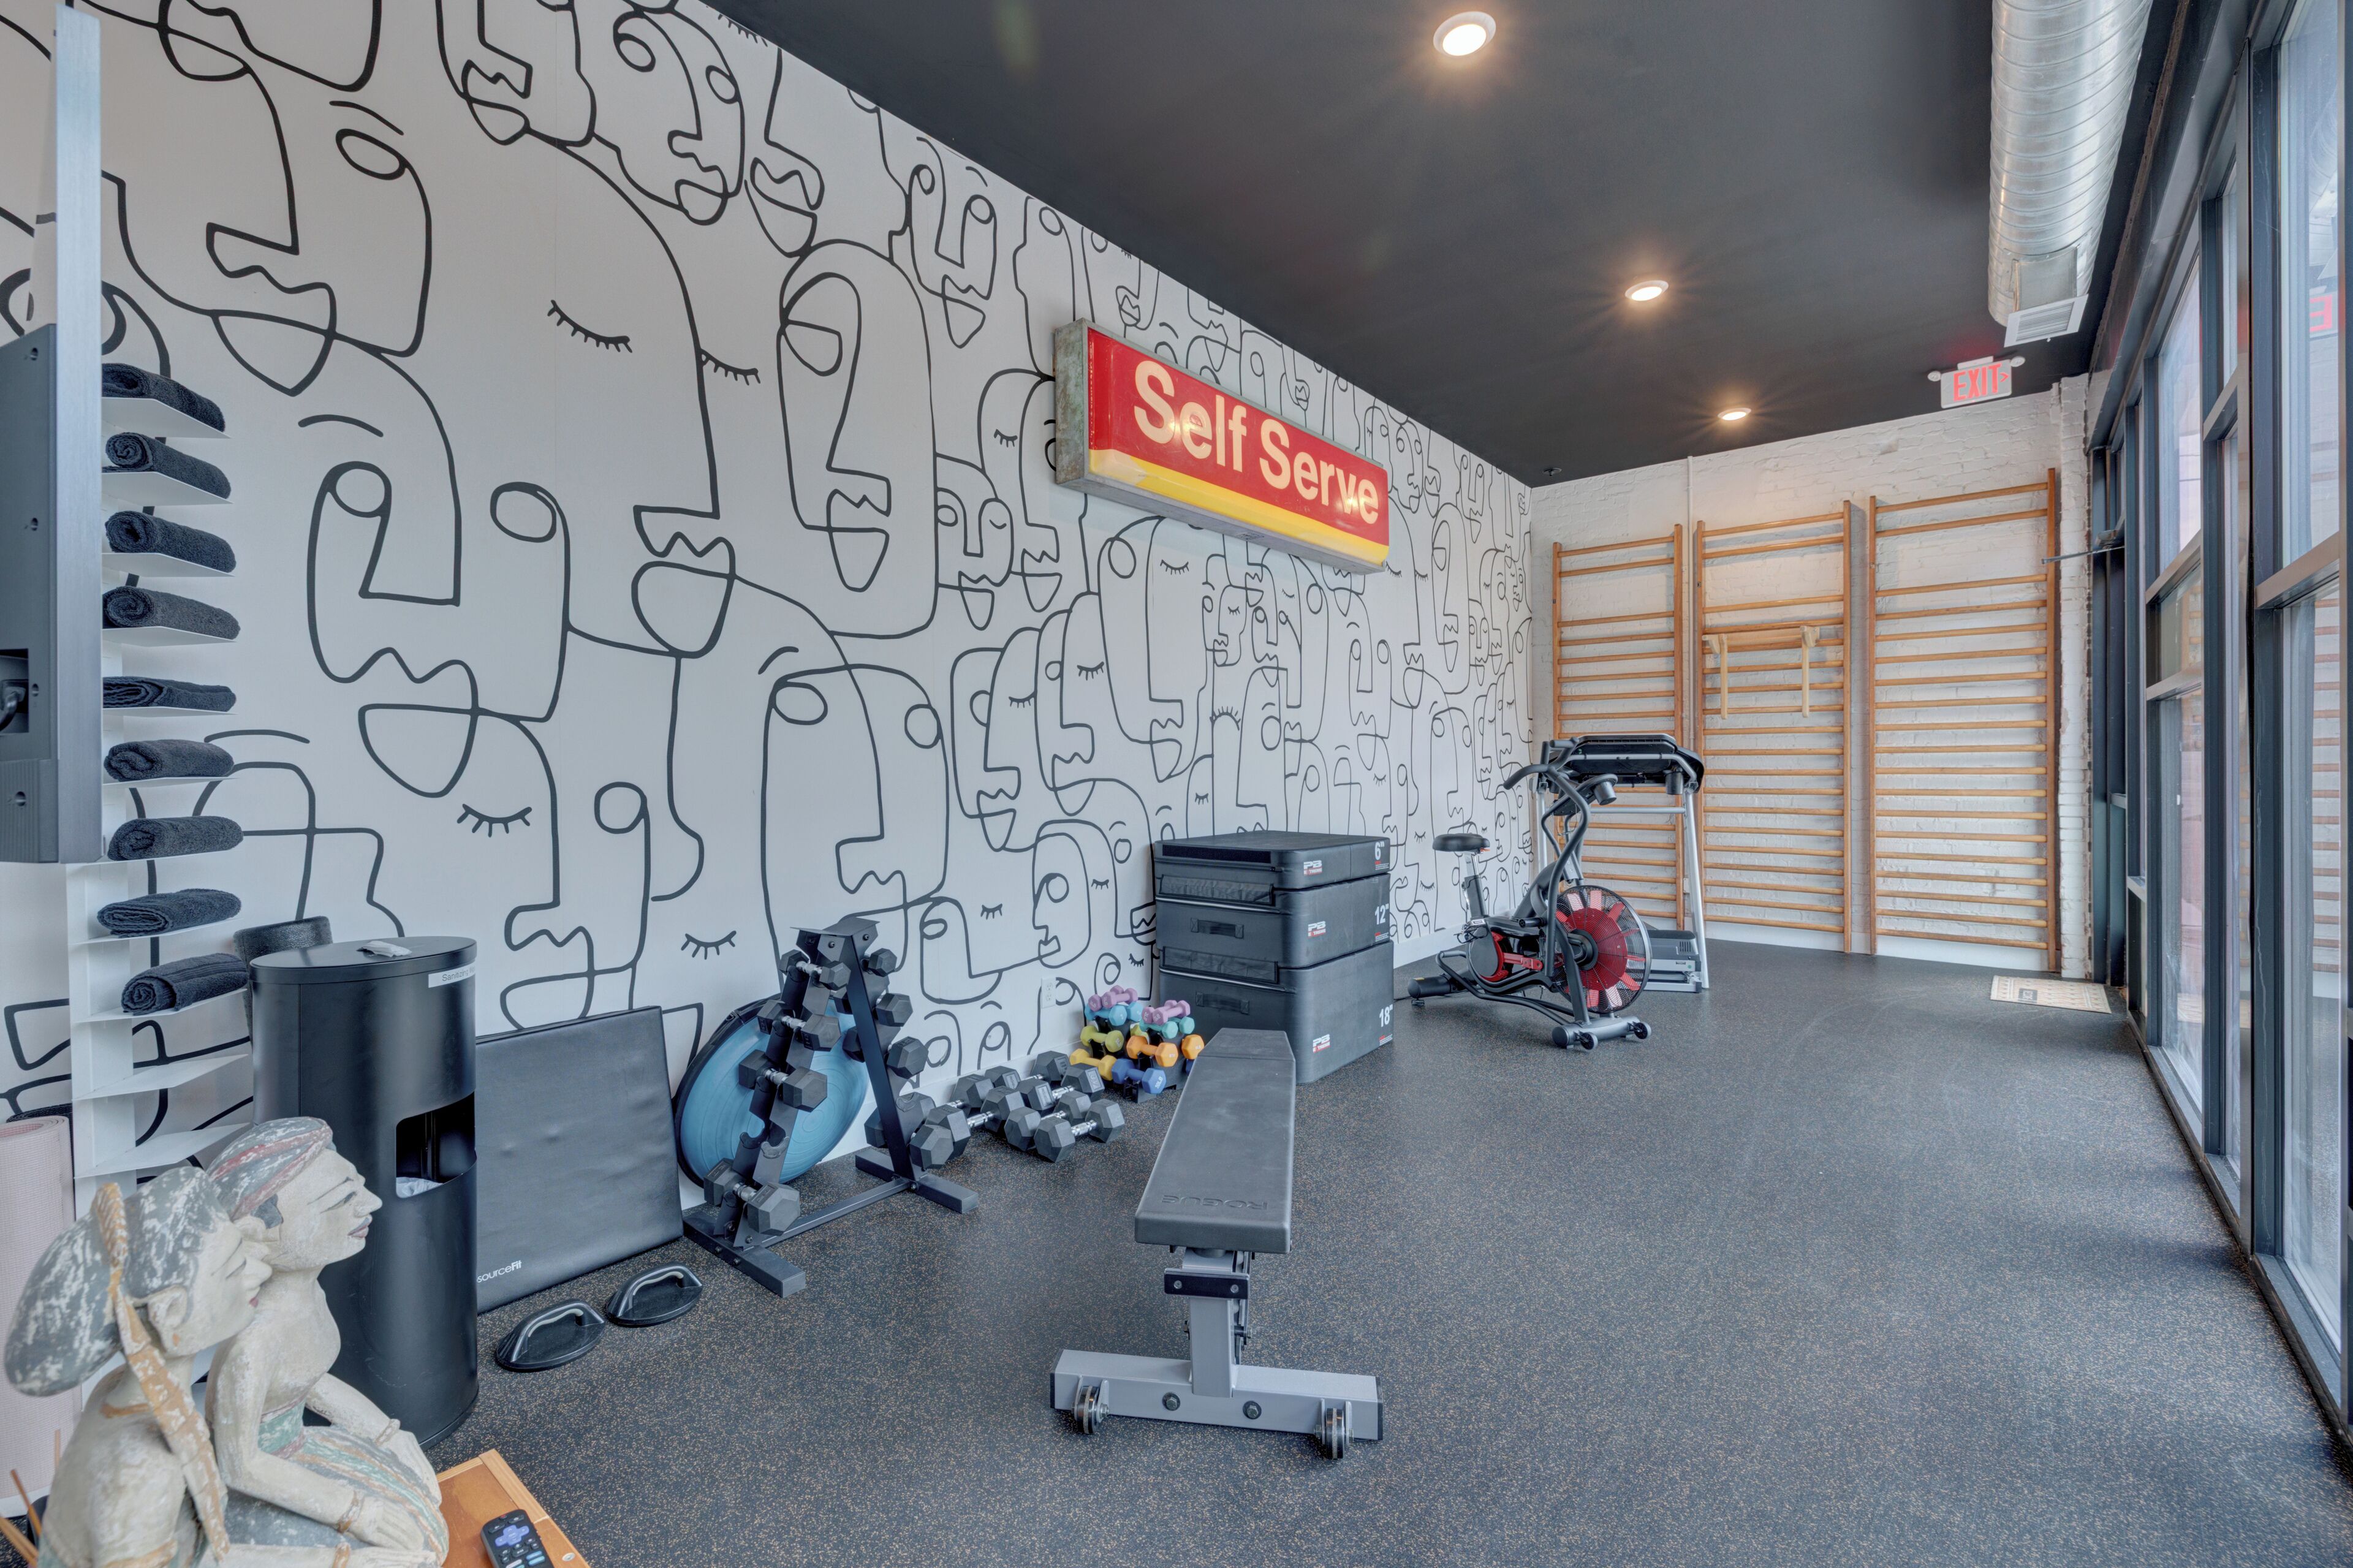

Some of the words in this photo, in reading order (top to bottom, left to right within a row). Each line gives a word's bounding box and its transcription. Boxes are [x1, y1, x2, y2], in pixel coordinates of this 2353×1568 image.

[1953, 363, 2002, 402] EXIT
[1134, 360, 1248, 473] Self
[1259, 419, 1379, 525] Serve
[1303, 860, 1322, 869] PB
[1374, 903, 1389, 925] 12"
[1308, 920, 1326, 931] PB
[442, 969, 469, 982] Sanitizing
[1379, 1004, 1393, 1028] 18"
[1313, 1034, 1330, 1047] PB
[1161, 1194, 1268, 1210] ROGUE
[476, 1260, 522, 1283] sourceFit
